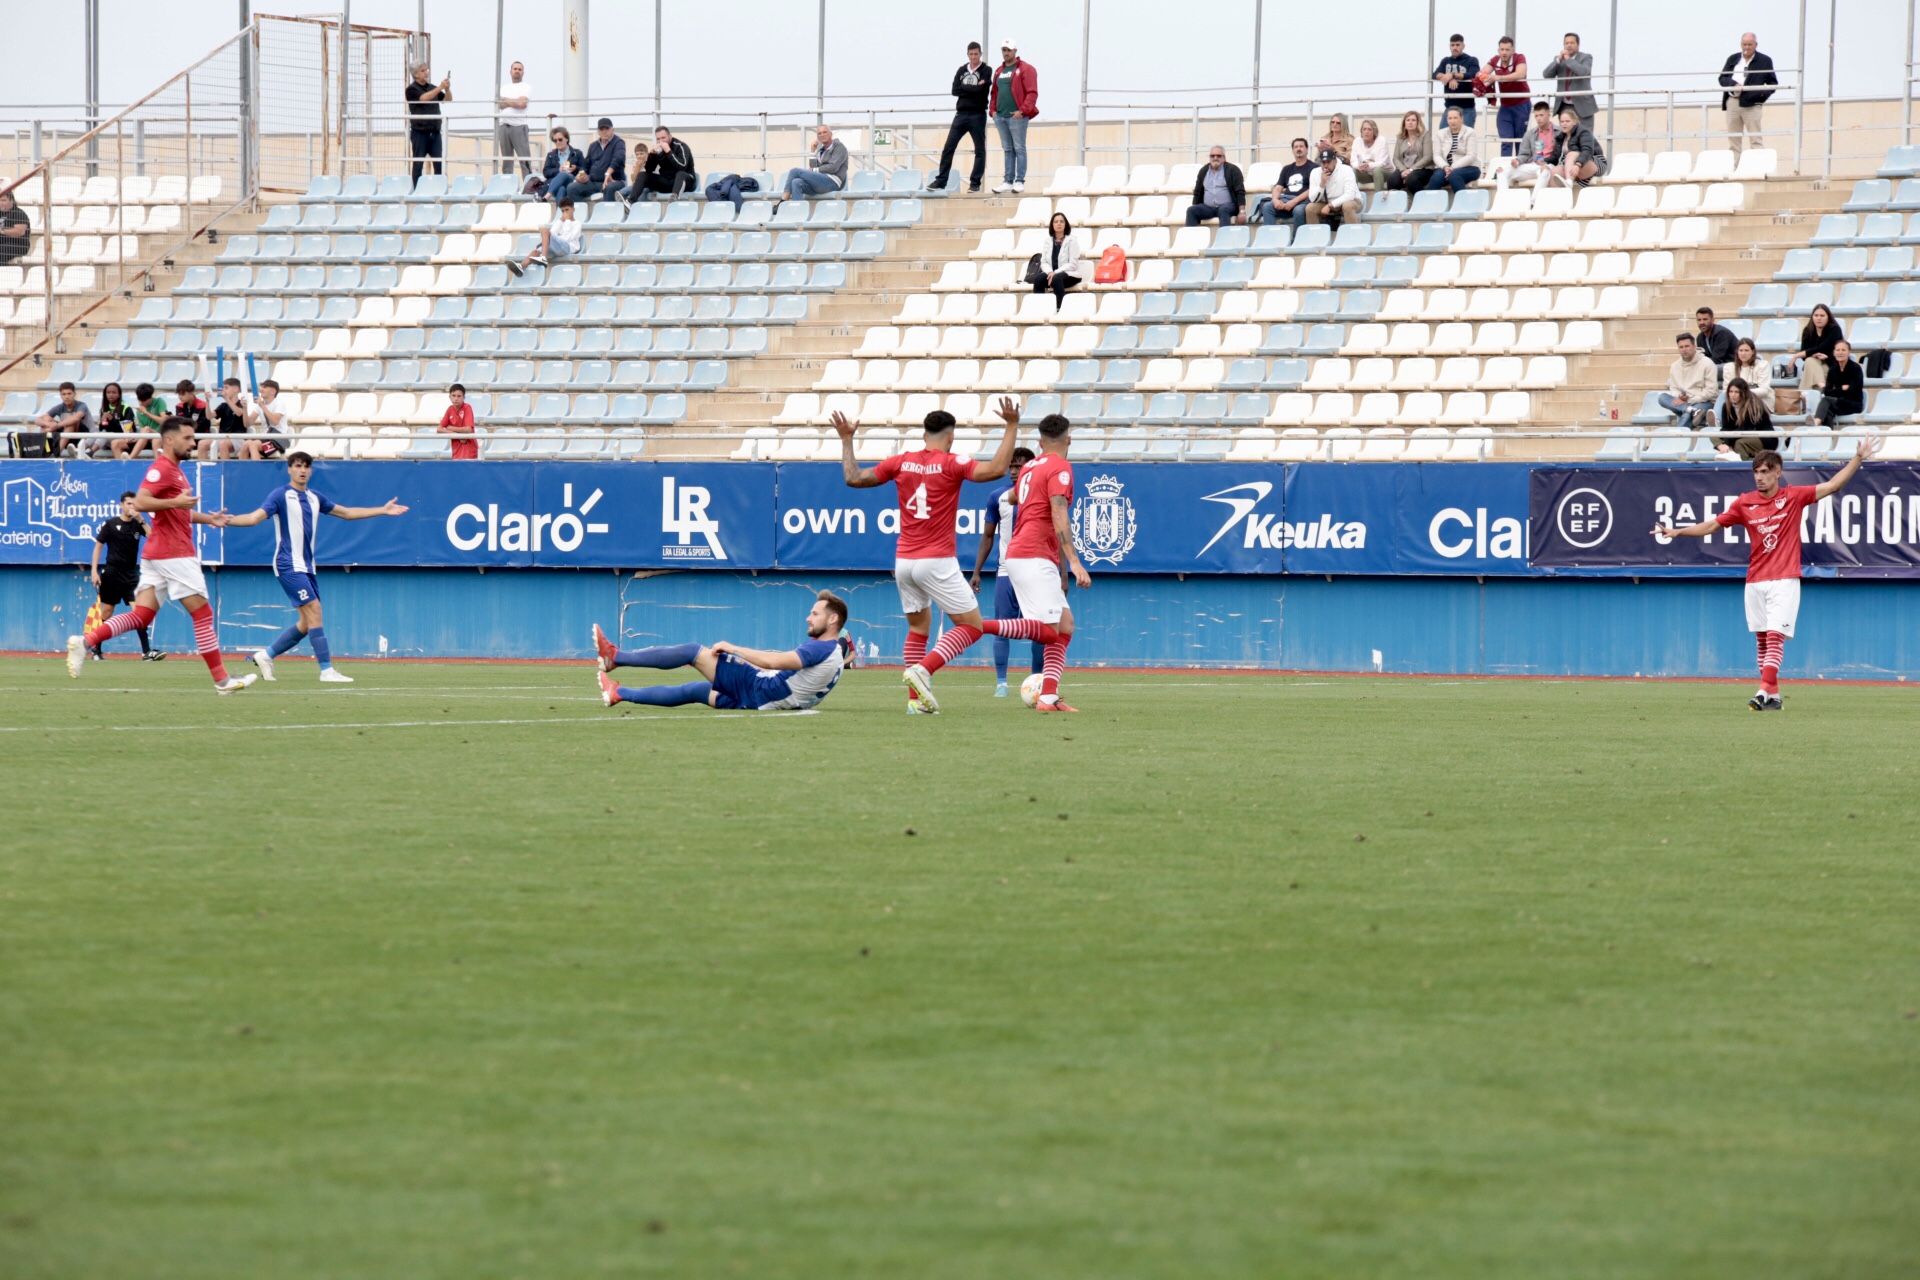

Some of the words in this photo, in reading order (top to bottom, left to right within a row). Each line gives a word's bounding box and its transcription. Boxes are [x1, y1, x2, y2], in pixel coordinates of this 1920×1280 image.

[905, 482, 932, 520] 4
[1019, 471, 1033, 505] 6
[46, 495, 122, 522] Lorqui
[783, 508, 866, 535] own
[446, 503, 585, 552] Claro
[1243, 513, 1367, 549] Keuka
[673, 548, 688, 556] LEGAL
